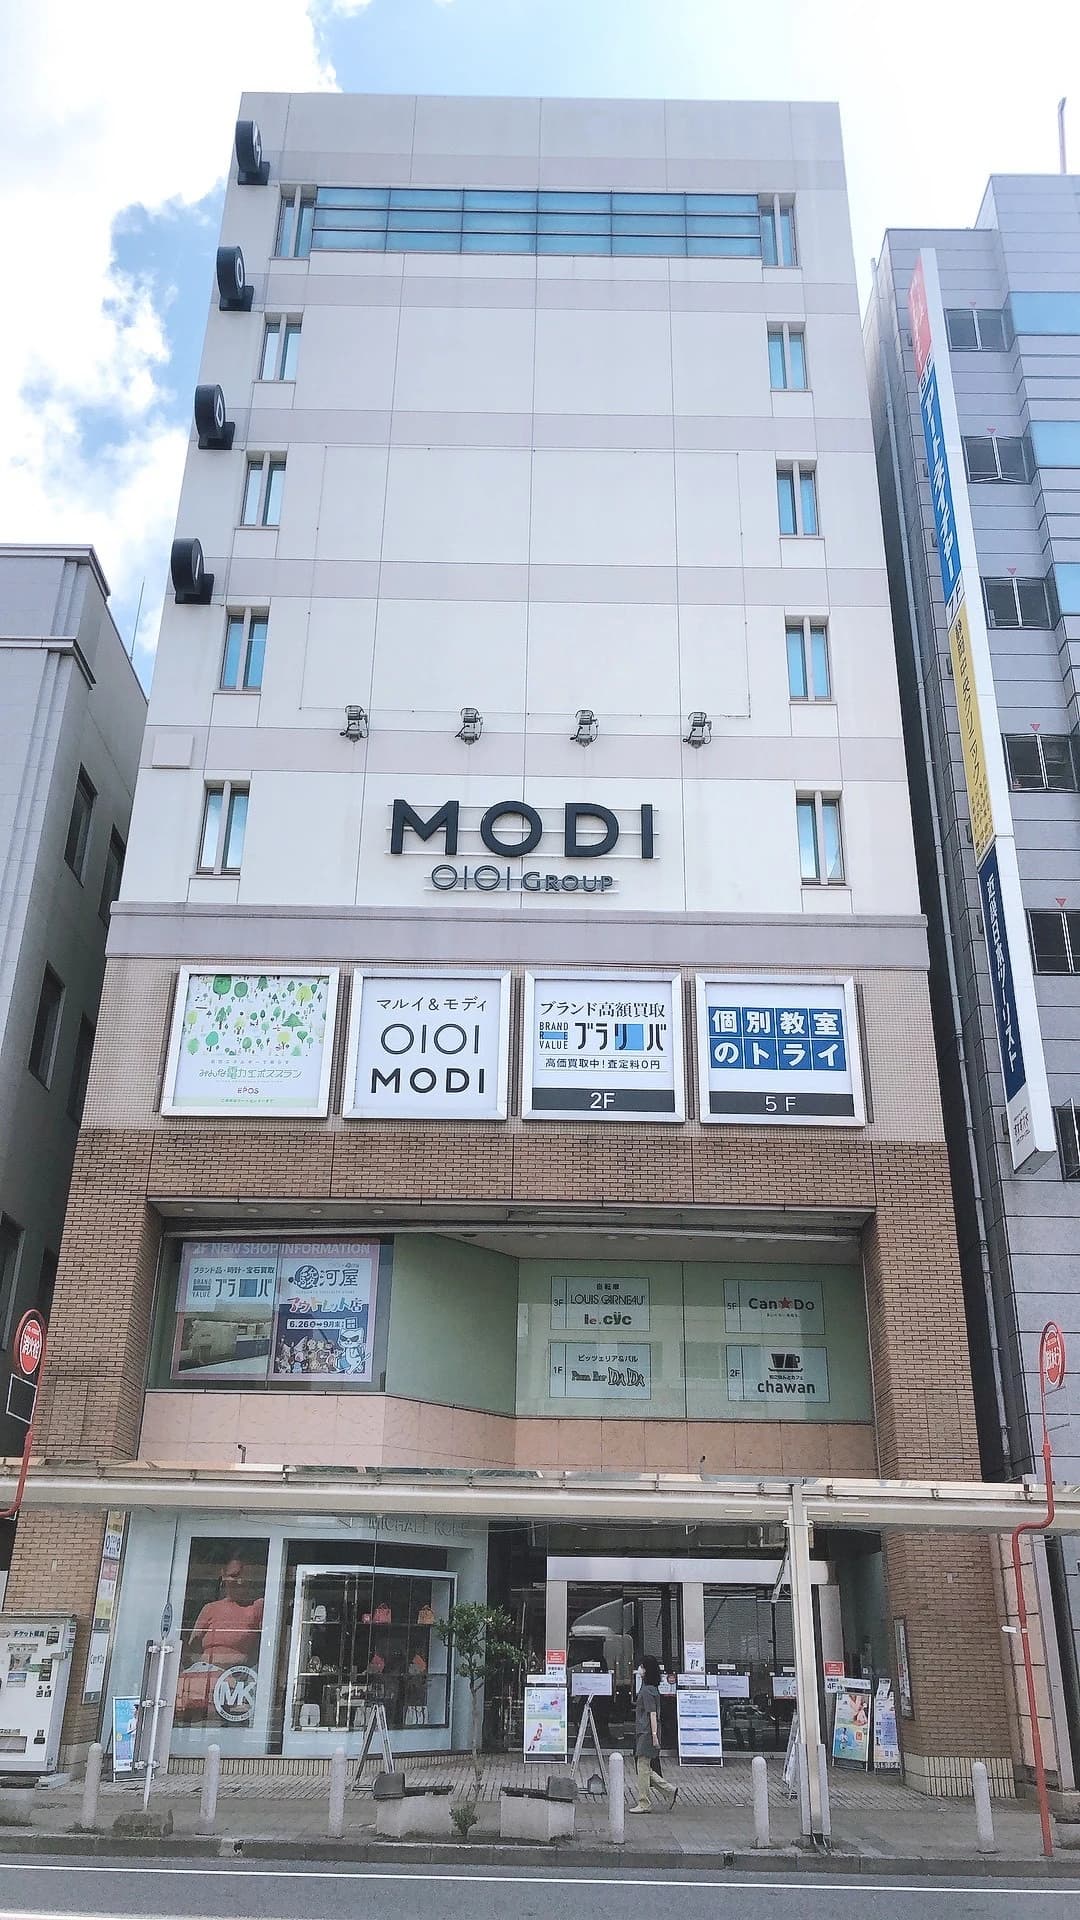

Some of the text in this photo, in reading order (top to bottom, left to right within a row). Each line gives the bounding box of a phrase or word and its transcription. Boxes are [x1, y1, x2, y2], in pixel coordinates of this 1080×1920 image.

[390, 799, 653, 859] MODI
[986, 873, 1017, 1072] 近畿日本ツーリスト
[540, 1000, 665, 1018] ブランド高額買取
[539, 1022, 569, 1031] BRAND
[712, 1009, 840, 1036] 個別教室
[380, 1023, 480, 1055] OIOI
[539, 1041, 569, 1050] VALUE
[574, 1022, 667, 1051] ブラリバ
[714, 1042, 839, 1067] のトライ
[371, 1067, 485, 1094] MODI
[237, 1086, 260, 1095] EPOS
[590, 1092, 615, 1109] 2F
[211, 1244, 241, 1255] NEW
[243, 1244, 279, 1255] SHOP
[281, 1244, 370, 1255] INFORMATION
[294, 1264, 359, 1290] 駿河屋
[596, 1282, 620, 1290] 自転車
[215, 1278, 272, 1298] ブラバ
[287, 1296, 364, 1313] アウトレット店
[553, 1298, 564, 1307] 3F
[570, 1293, 599, 1305] LOUIS
[727, 1302, 737, 1310] 5F
[553, 1366, 563, 1374] 1F
[729, 1369, 816, 1394] 2F chawan
[219, 1681, 257, 1706] MK
